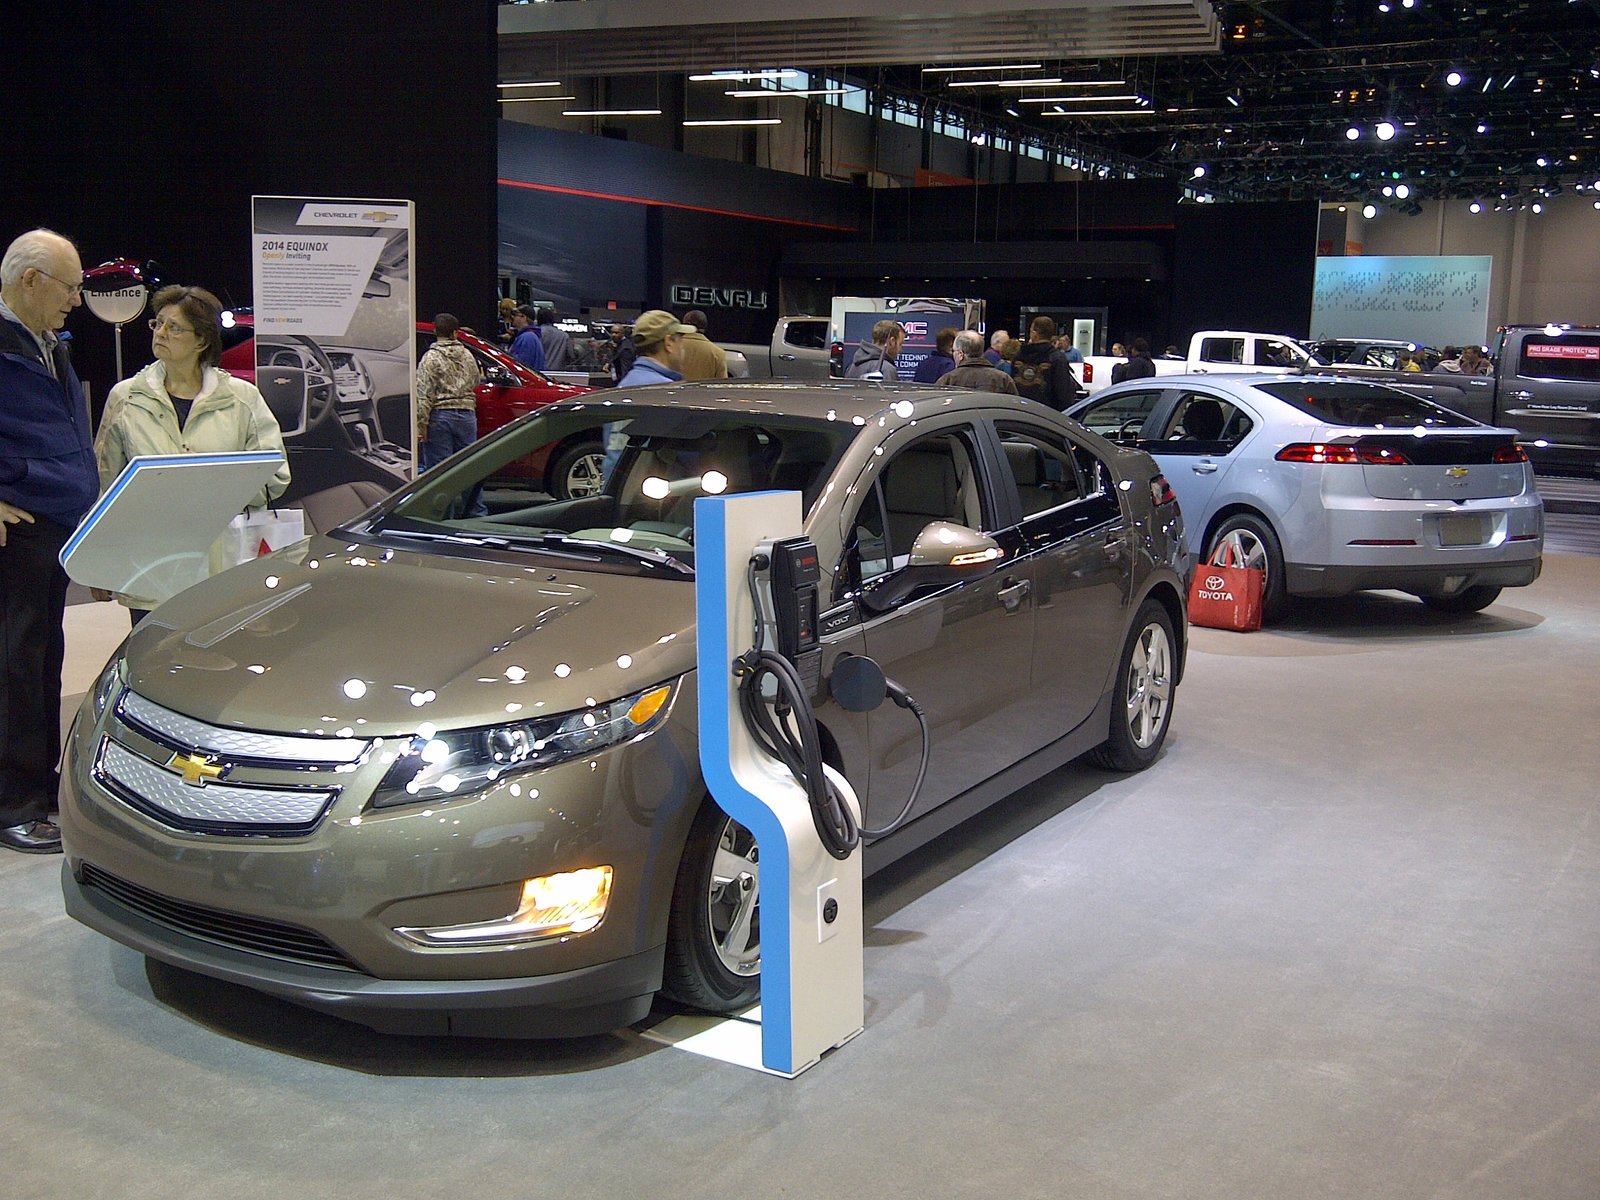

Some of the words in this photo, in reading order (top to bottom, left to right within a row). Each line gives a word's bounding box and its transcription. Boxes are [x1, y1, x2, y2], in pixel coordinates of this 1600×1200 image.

[262, 241, 285, 251] 2014
[286, 241, 328, 251] EQUINOX
[262, 252, 285, 261] Openly
[286, 252, 311, 260] Inviting
[672, 285, 768, 309] DENALI
[896, 321, 928, 334] MC
[1198, 590, 1233, 601] TOYOTA
[827, 615, 850, 627] VOLT
